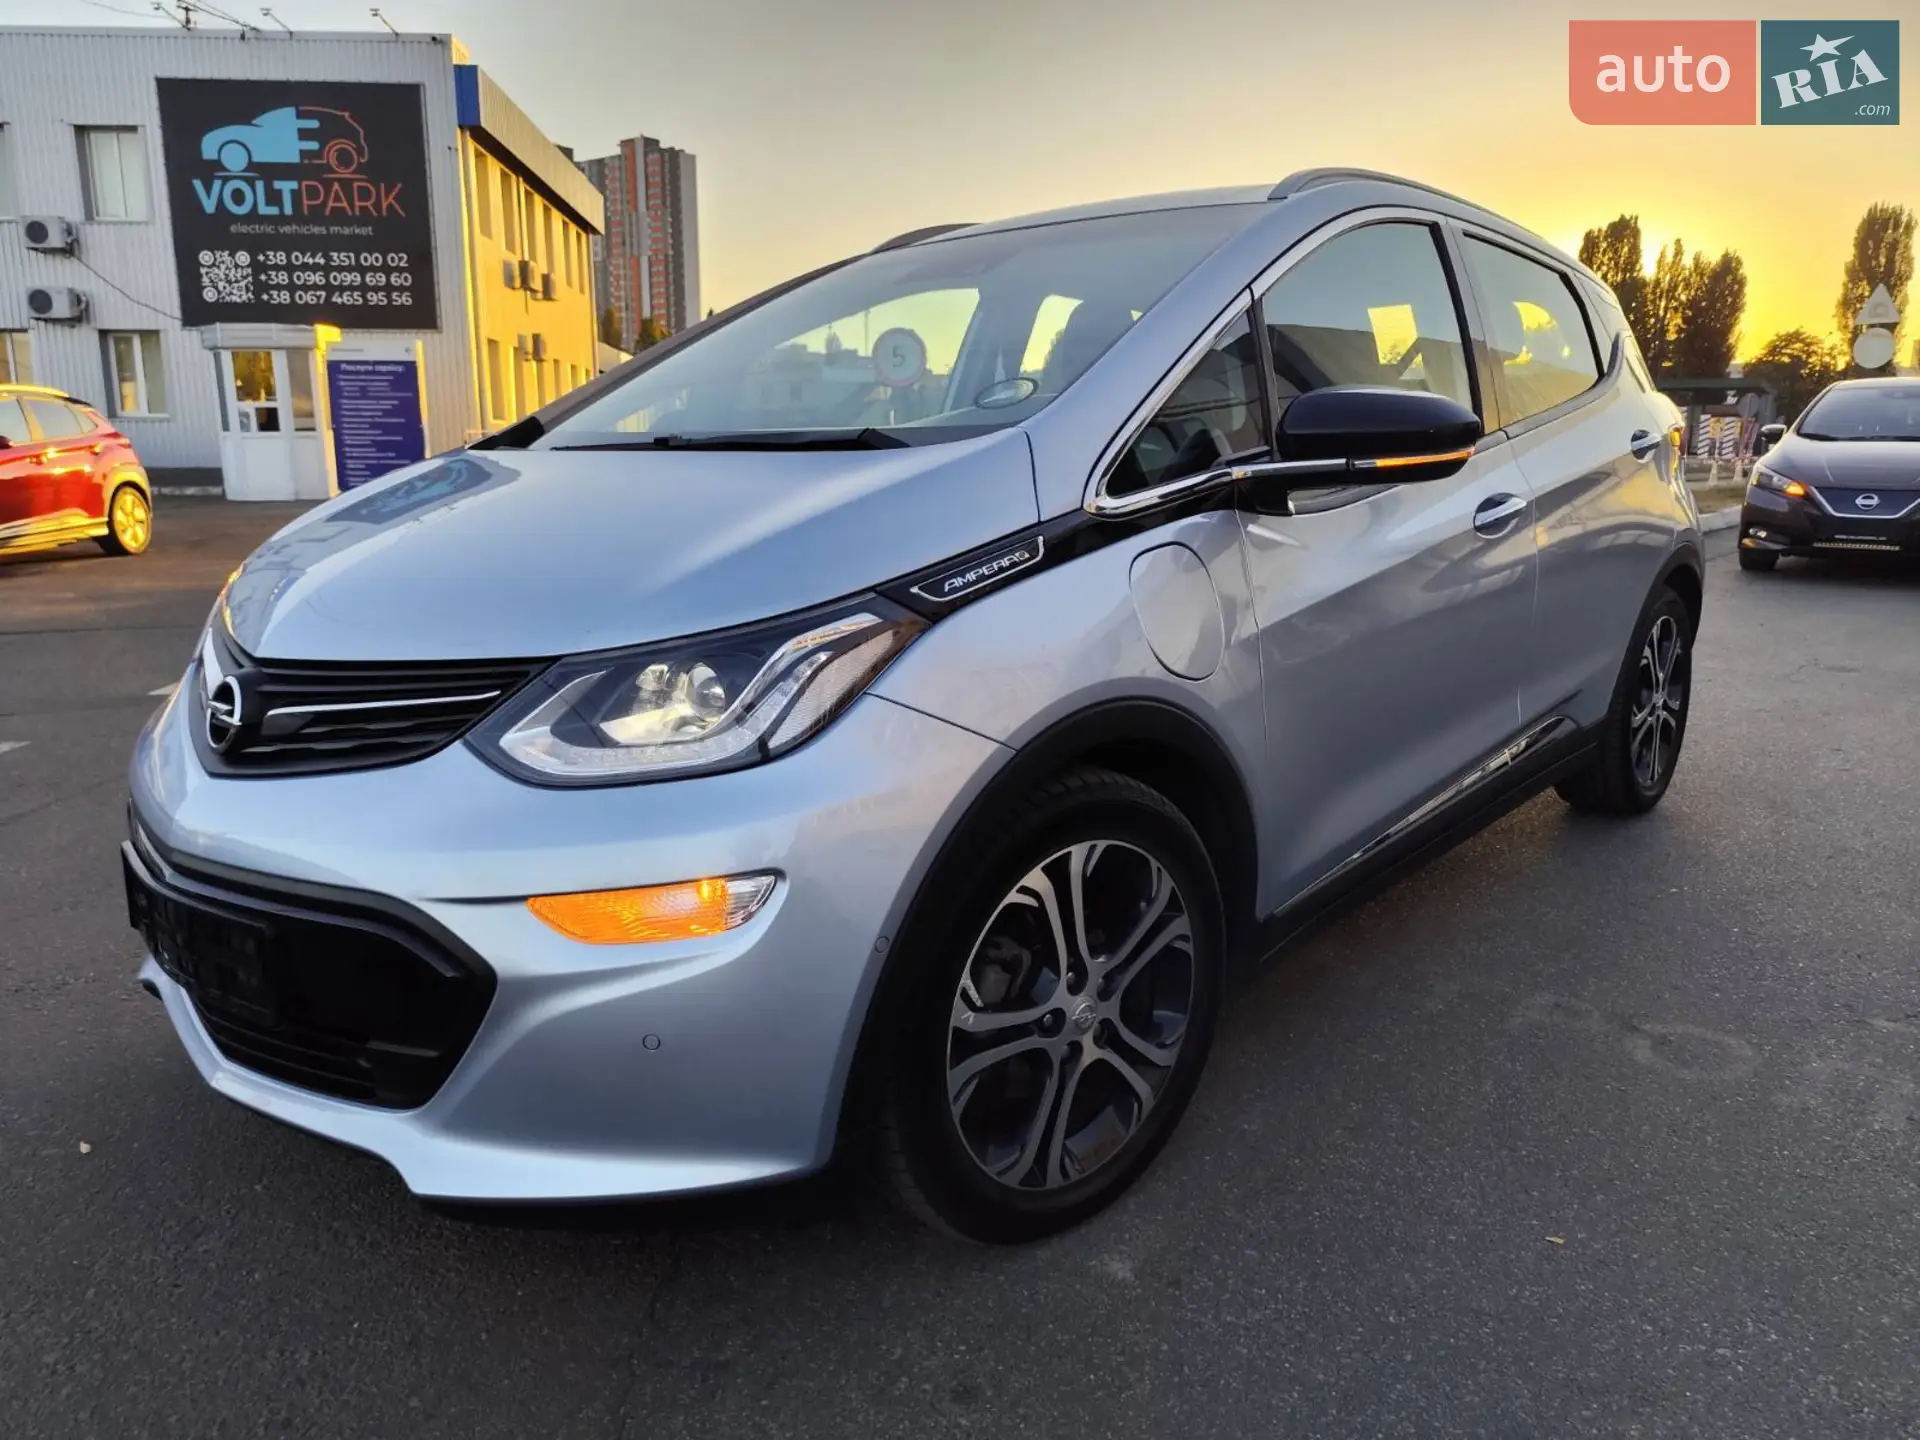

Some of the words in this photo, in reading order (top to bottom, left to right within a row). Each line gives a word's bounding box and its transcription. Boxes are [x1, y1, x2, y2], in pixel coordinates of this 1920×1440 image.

[230, 222, 275, 234] electric
[278, 223, 327, 235] vehicles
[330, 224, 374, 236] market
[257, 251, 287, 265] +38
[291, 251, 326, 266] 044
[329, 252, 355, 266] 351
[360, 253, 383, 267] 00
[387, 253, 409, 267] 02
[258, 271, 289, 285] +38
[293, 271, 326, 285] 096
[329, 272, 361, 286] 099
[365, 272, 386, 286] 69
[390, 273, 413, 286] 60
[260, 290, 291, 304] +38
[295, 291, 327, 304] 067
[331, 292, 363, 305] 465
[366, 292, 388, 306] 95
[391, 292, 413, 306] 56
